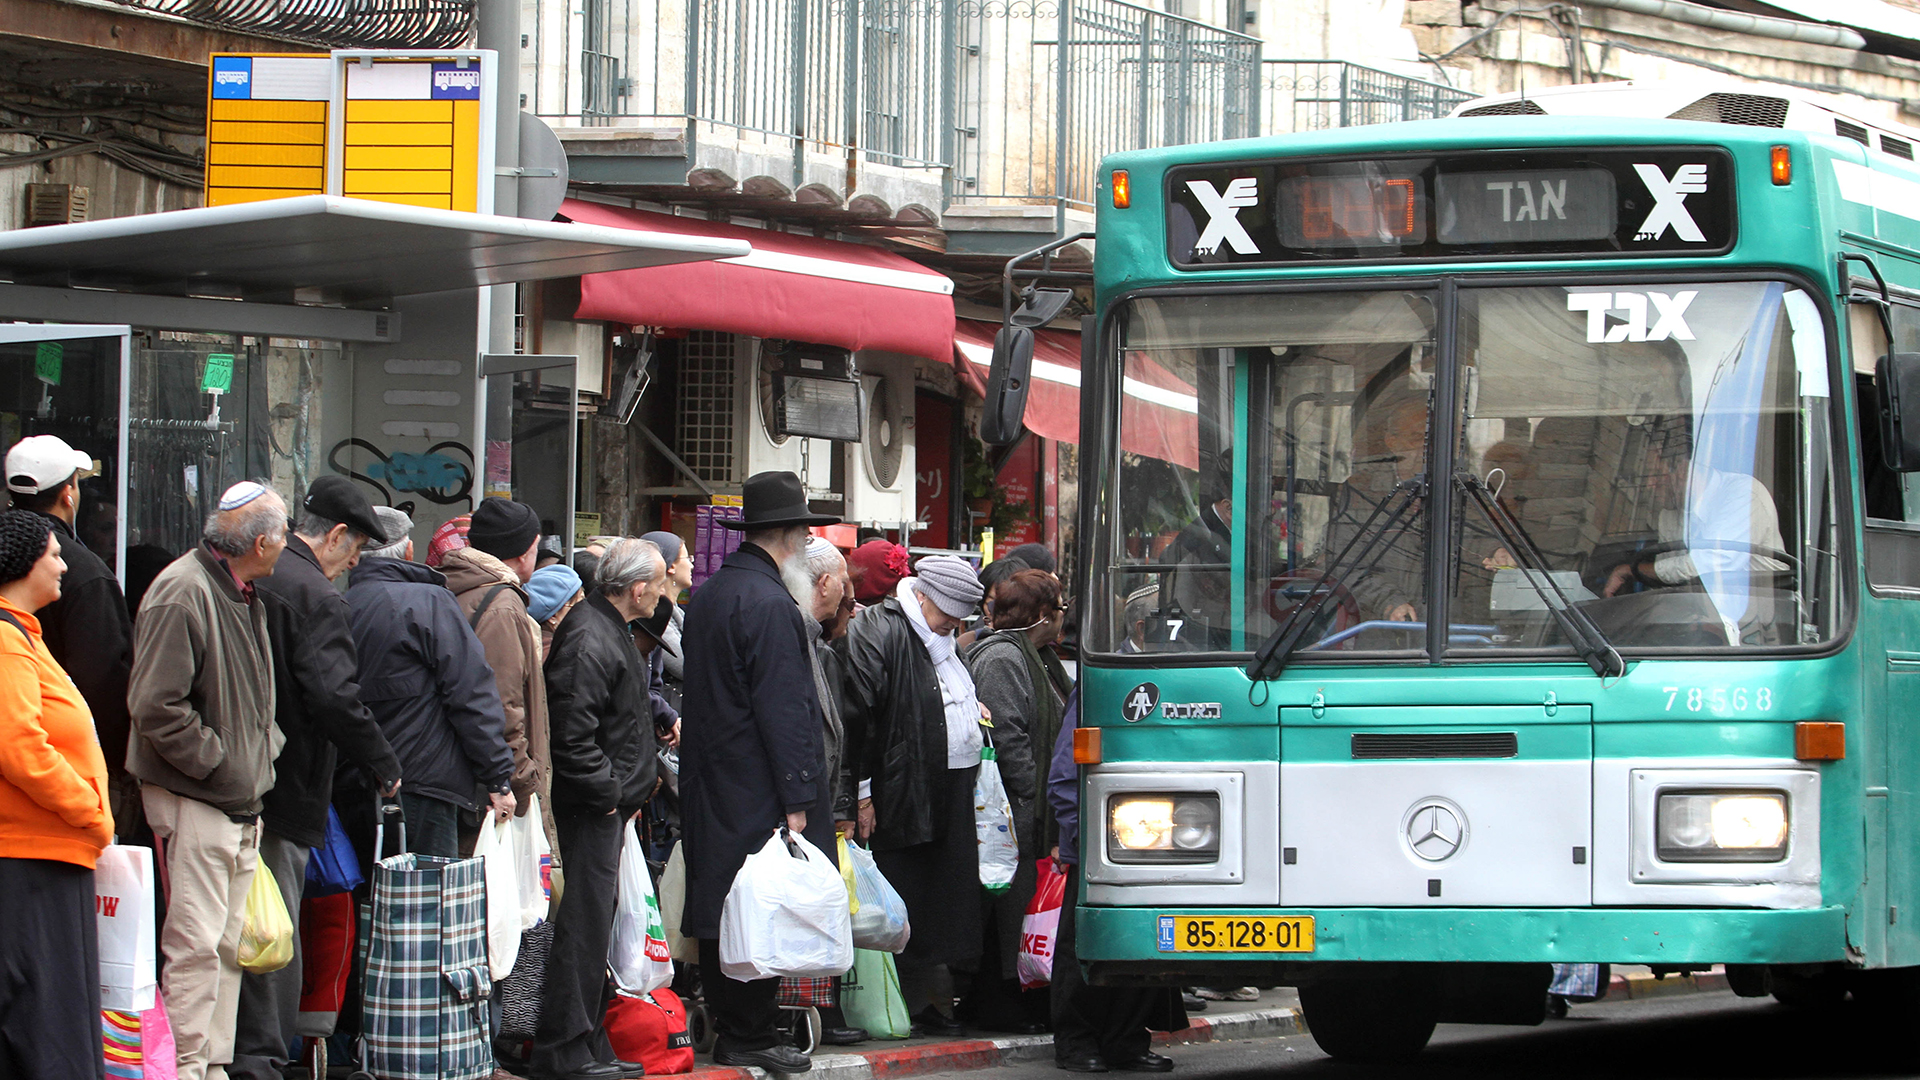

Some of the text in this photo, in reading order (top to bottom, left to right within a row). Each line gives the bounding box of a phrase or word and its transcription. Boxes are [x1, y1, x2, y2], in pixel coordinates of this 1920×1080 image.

[1486, 179, 1567, 222] אגד
[1567, 291, 1699, 343] אגד
[1166, 619, 1184, 641] 7
[1160, 702, 1222, 719] הארגז
[1662, 686, 1772, 712] 78568
[1163, 928, 1172, 941] IL
